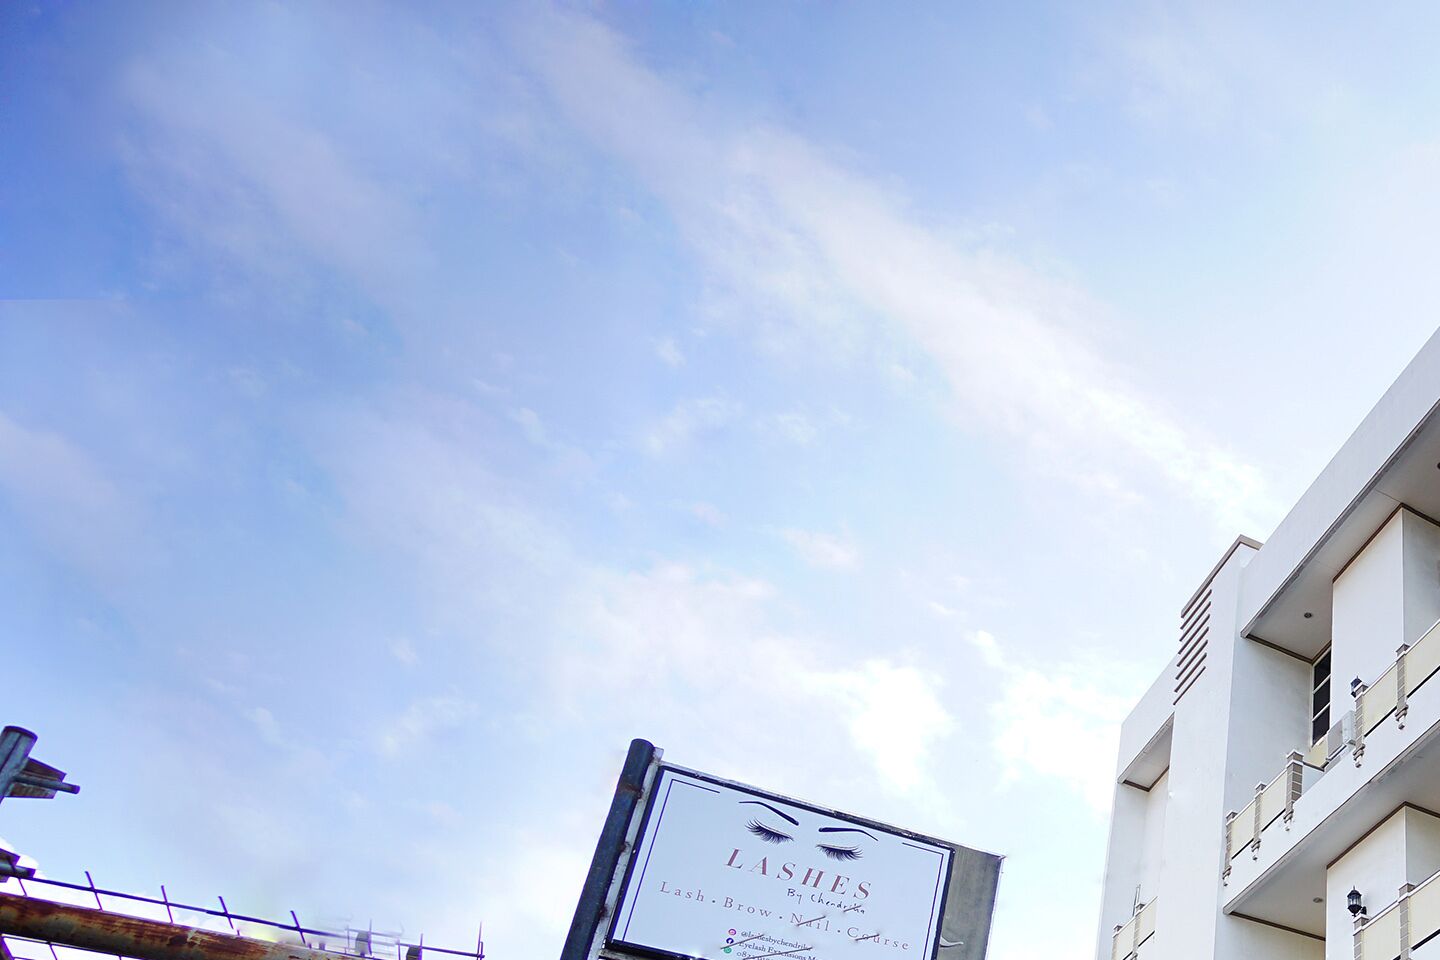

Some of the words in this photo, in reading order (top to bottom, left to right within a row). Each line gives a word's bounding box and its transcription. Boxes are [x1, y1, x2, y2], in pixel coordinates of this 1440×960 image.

[724, 848, 872, 900] LASHES
[659, 880, 705, 902] Lash
[723, 897, 773, 918] Brow
